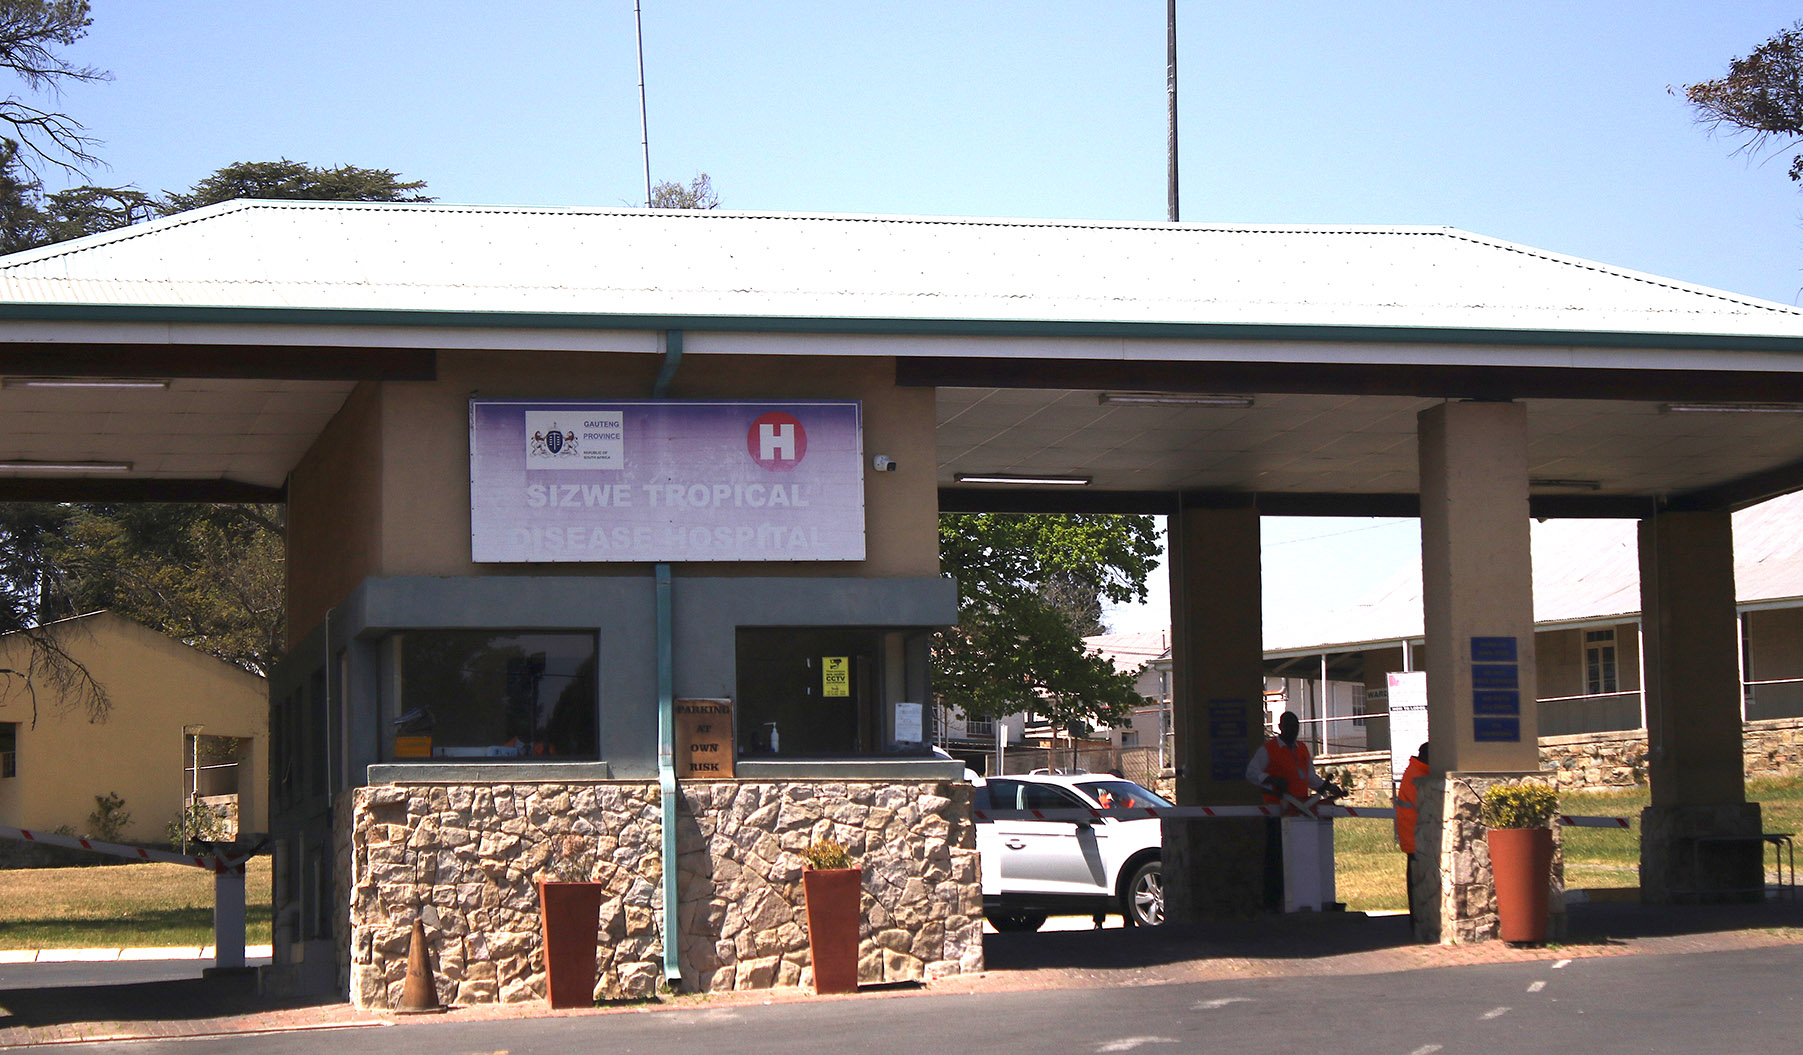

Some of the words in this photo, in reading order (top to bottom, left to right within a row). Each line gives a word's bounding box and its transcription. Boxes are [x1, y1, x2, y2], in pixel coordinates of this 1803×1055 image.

[583, 420, 620, 428] GAUTENG
[583, 432, 621, 440] PROVINCE
[759, 423, 795, 460] H
[526, 483, 632, 508] SIZWE
[642, 483, 809, 509] TROPICAL
[510, 526, 653, 551] DISEASE
[664, 524, 823, 551] HOSPITAL
[677, 705, 730, 714] PARKING
[696, 724, 712, 733] AT
[690, 743, 719, 752] OWN
[689, 762, 719, 772] RISK
